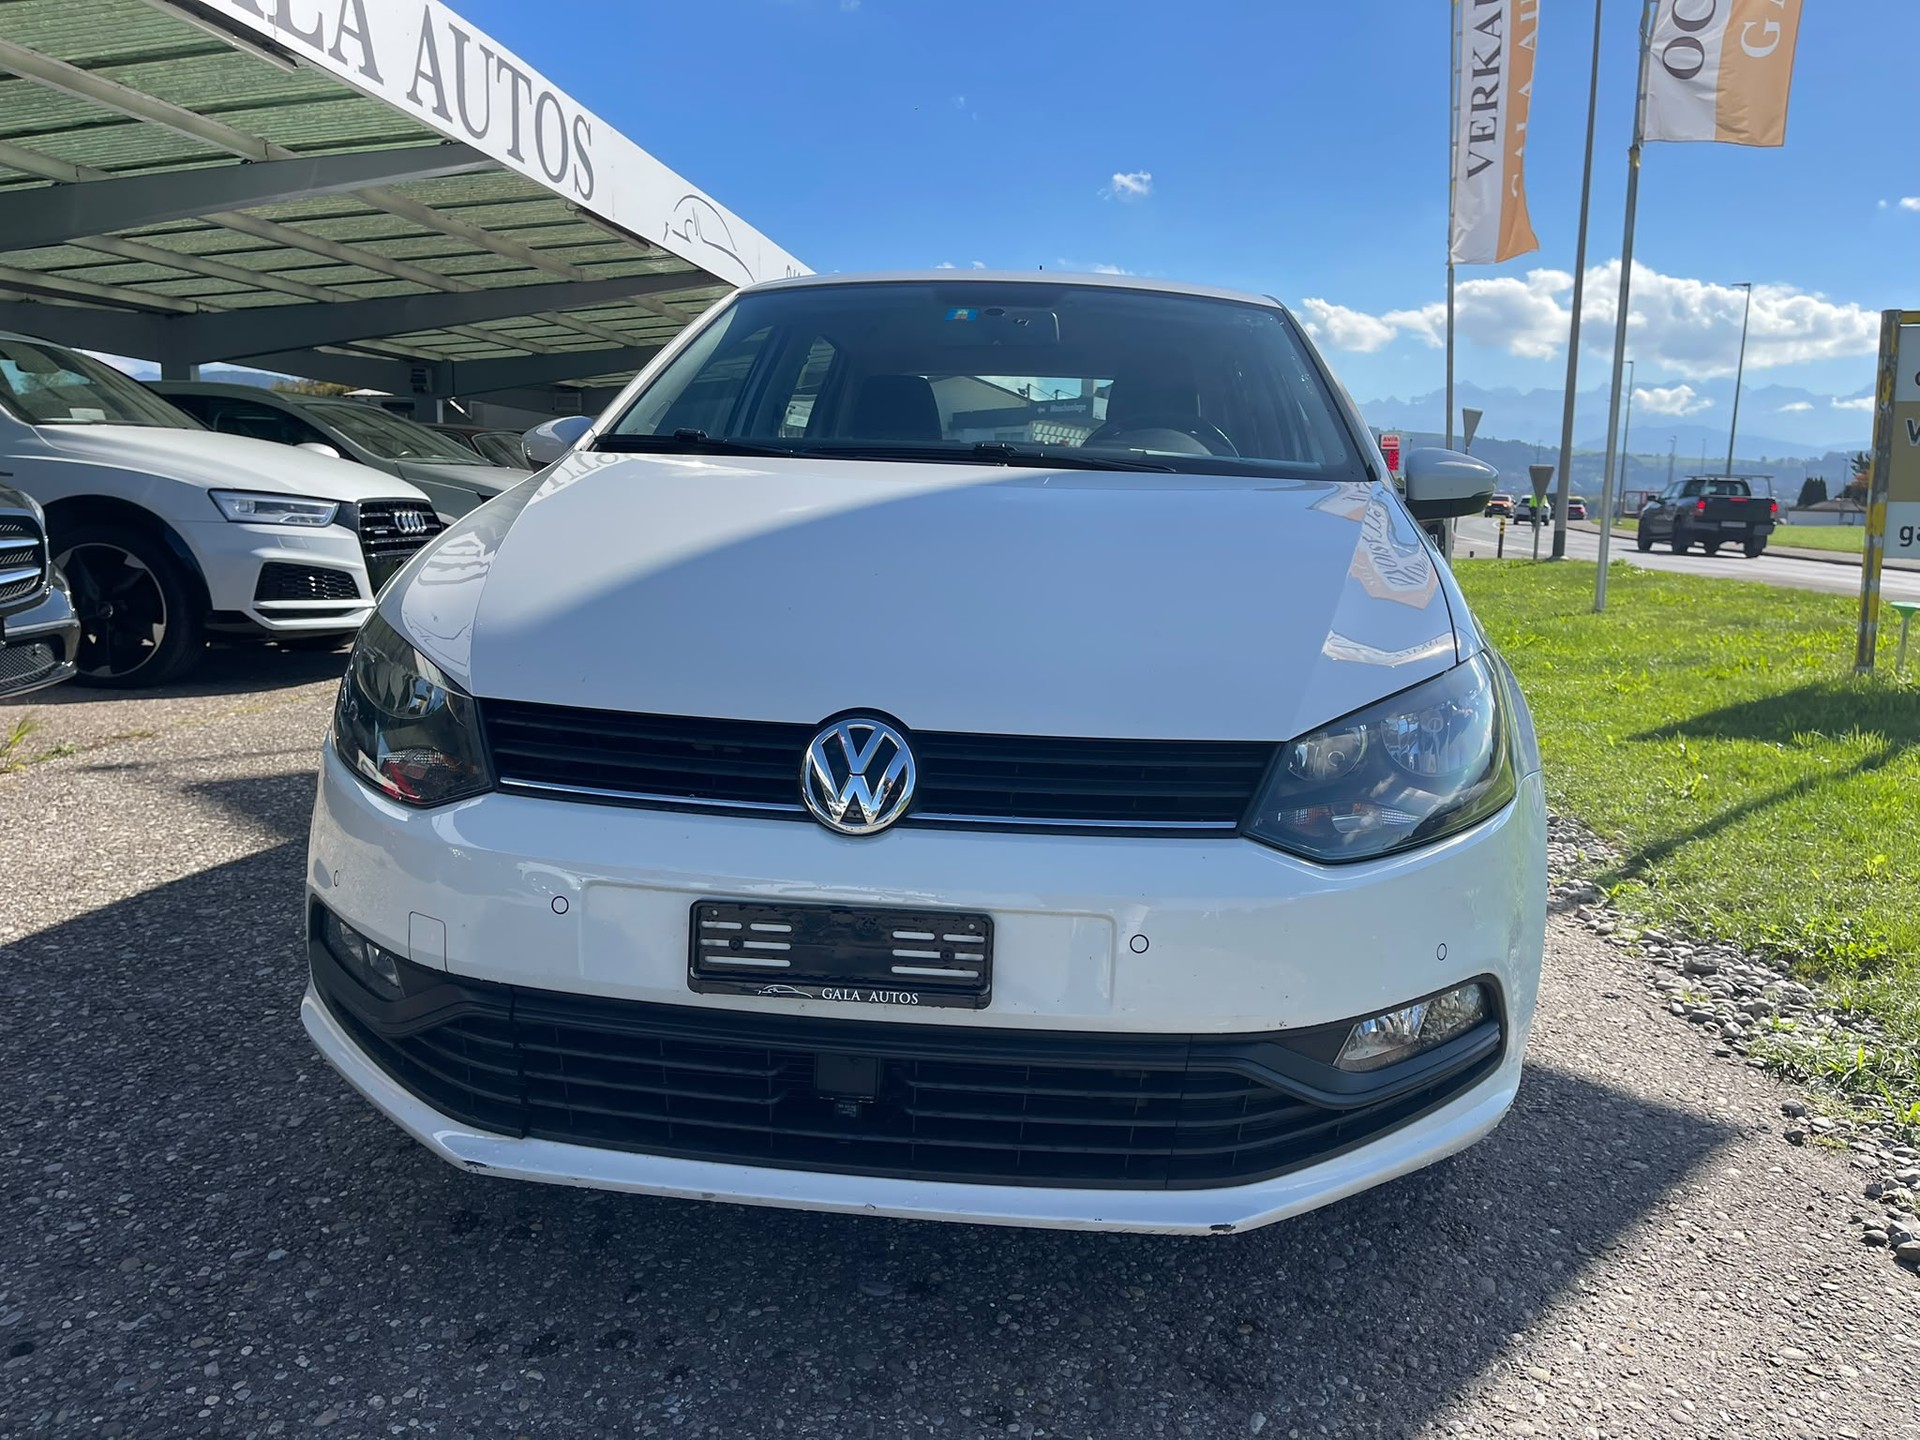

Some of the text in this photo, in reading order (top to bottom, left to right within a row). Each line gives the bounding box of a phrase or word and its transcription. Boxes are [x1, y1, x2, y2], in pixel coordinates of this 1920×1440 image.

[1740, 0, 1785, 58] G
[406, 4, 594, 202] AUTOS
[1466, 0, 1503, 179] VERKA
[821, 987, 919, 1005] GALA AUTOS
